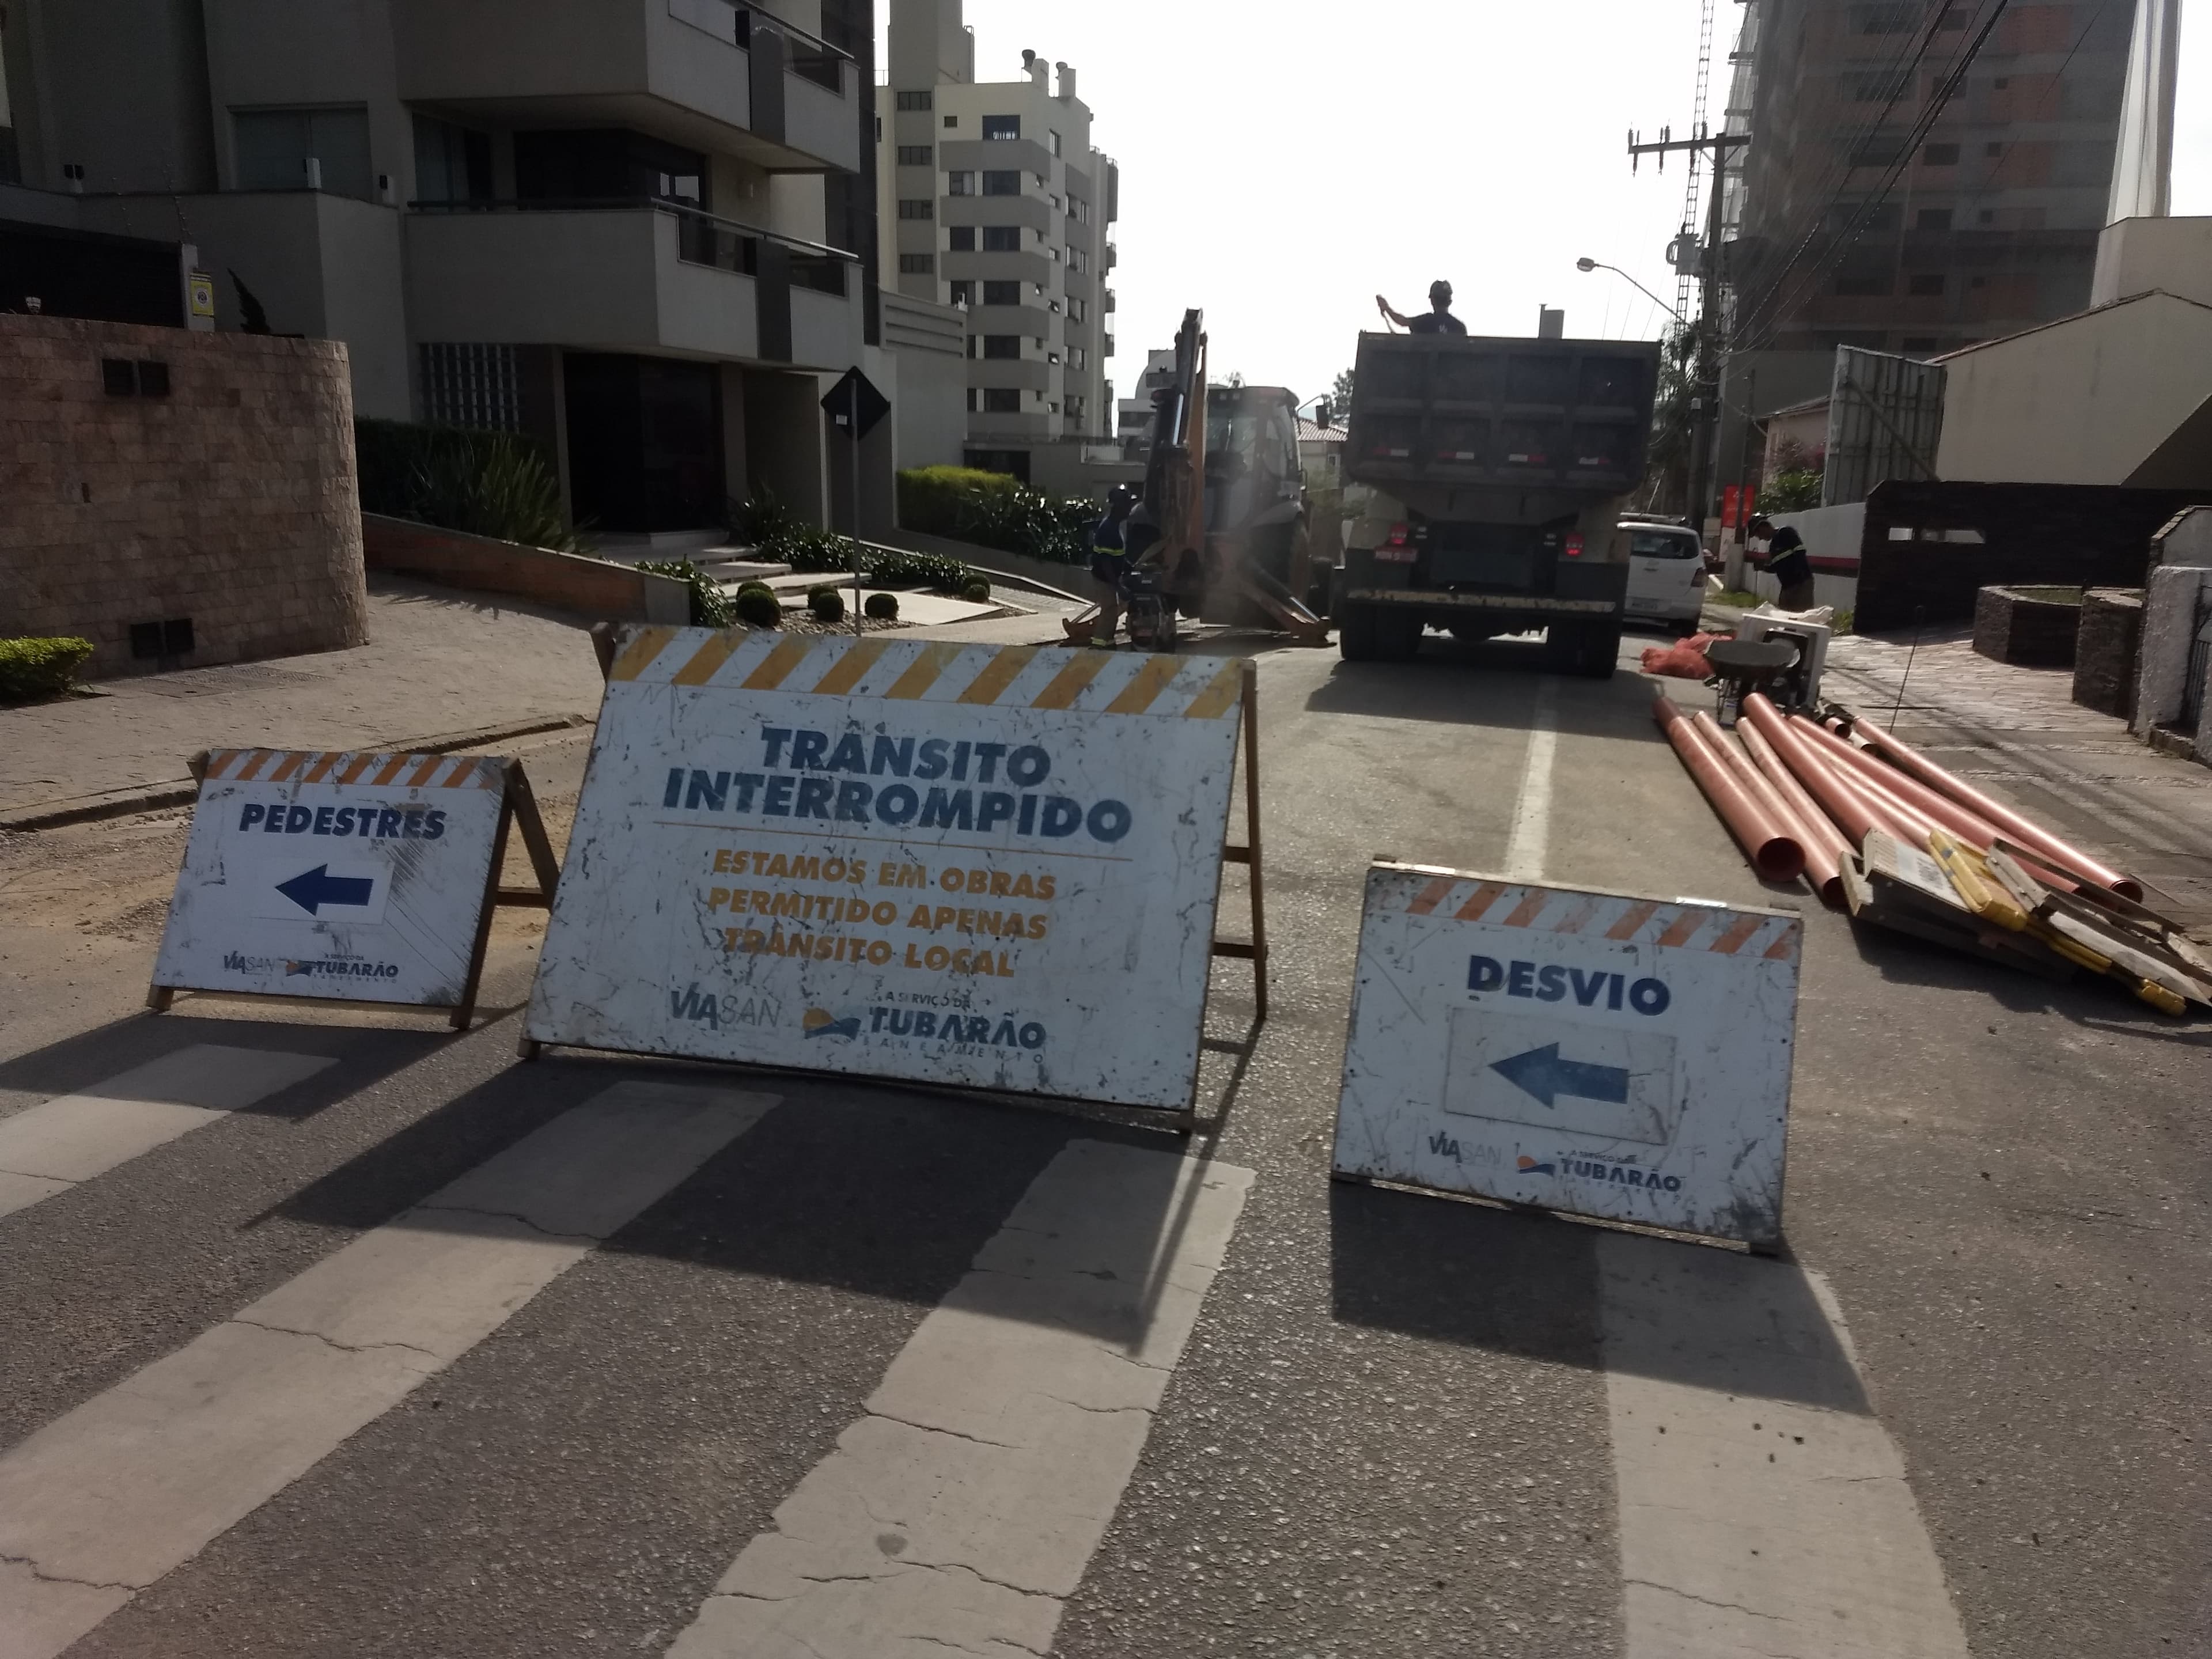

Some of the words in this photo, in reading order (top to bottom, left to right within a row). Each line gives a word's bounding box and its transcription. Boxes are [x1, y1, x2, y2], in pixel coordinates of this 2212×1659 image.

[760, 720, 1051, 787] TRÂNSITO
[239, 804, 447, 840] PEDESTRES
[662, 767, 1132, 843] INTERROMPIDO
[713, 849, 867, 884] ESTAMOS
[878, 861, 927, 889] EM
[939, 866, 1056, 900] OBRAS
[707, 887, 898, 926] PERMITIDO
[907, 904, 1048, 940] APENAS
[316, 961, 399, 978] TUBARÃO
[724, 925, 893, 965] TRÂNSITO
[904, 942, 1015, 978] LOCAL
[1468, 955, 1671, 1016] DESVIO
[870, 1006, 1046, 1050] TUBARÃO
[1561, 1158, 1681, 1192] TUBARÃO
